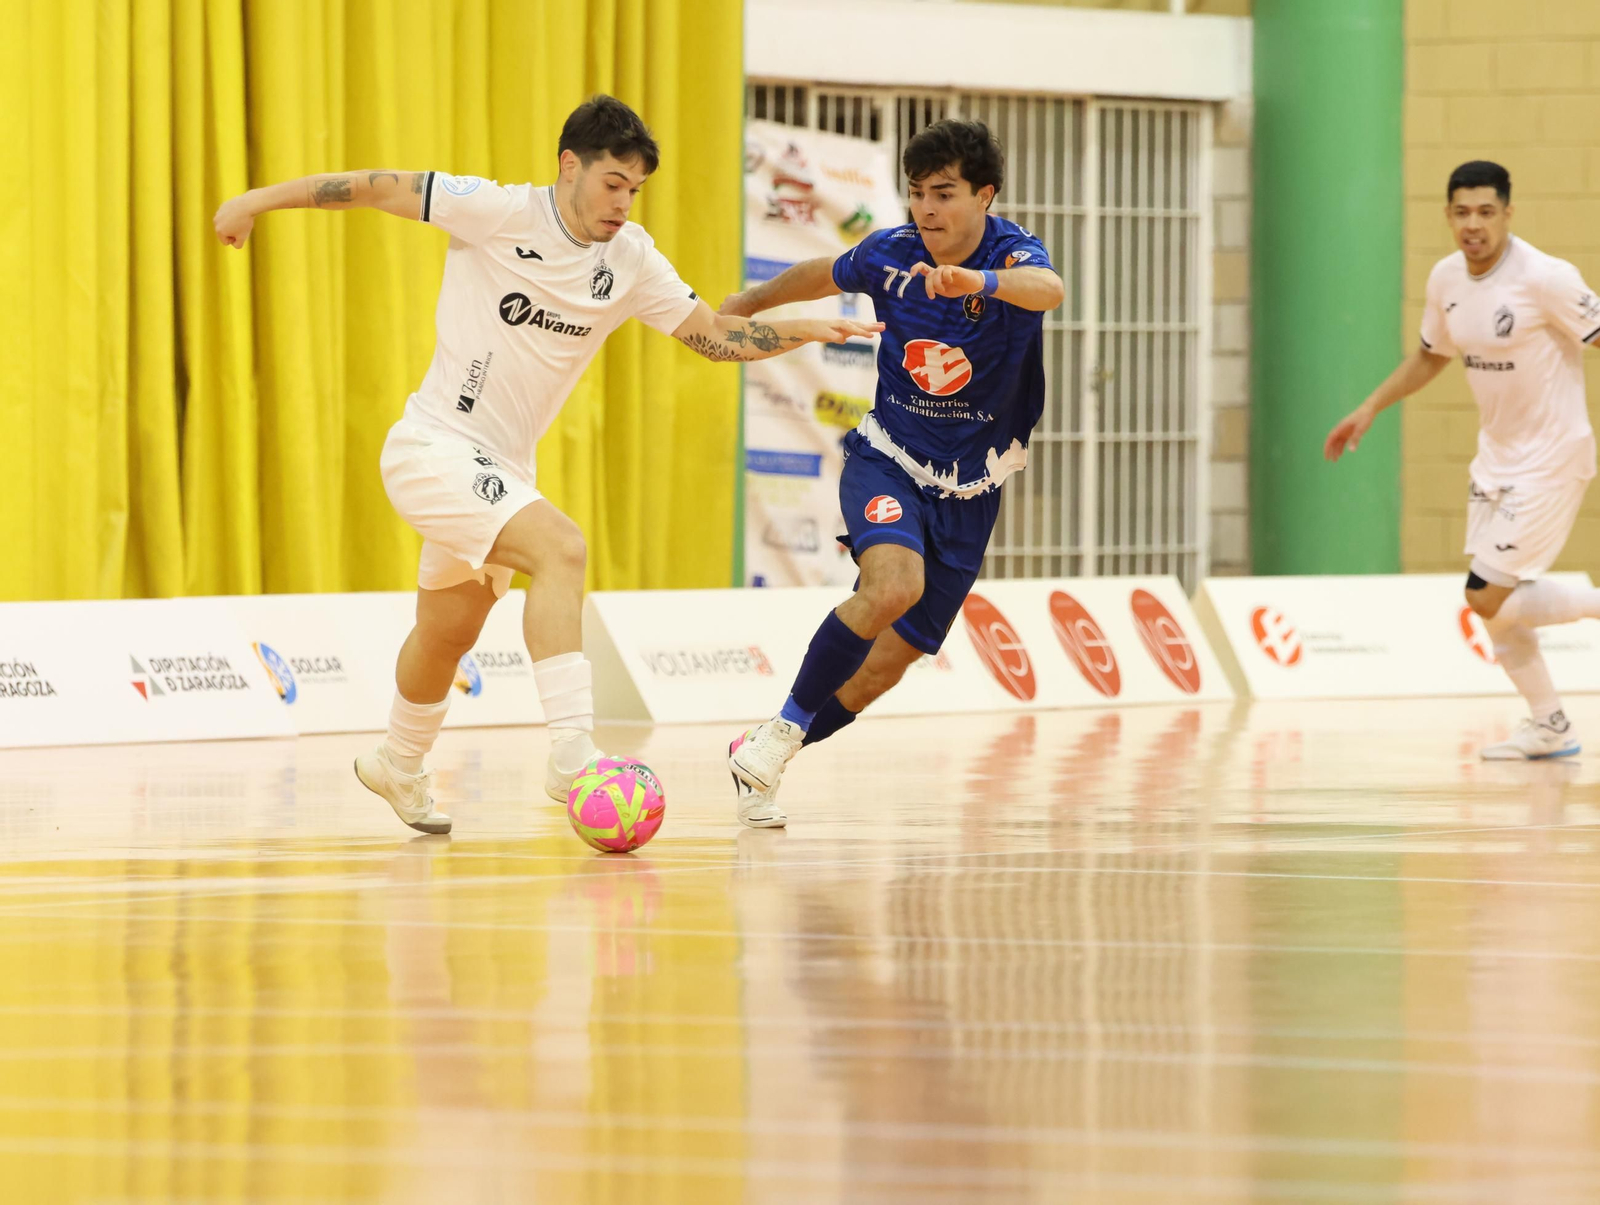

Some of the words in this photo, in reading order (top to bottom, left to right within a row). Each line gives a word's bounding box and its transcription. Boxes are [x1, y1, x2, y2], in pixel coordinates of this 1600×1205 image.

[882, 265, 912, 299] 77
[528, 308, 592, 336] Avanza
[461, 359, 482, 397] Jaén
[910, 394, 970, 408] Entrerríos
[148, 652, 231, 673] DIPUTACIÓN
[290, 655, 343, 674] SOLCAR
[475, 651, 524, 668] SOLCAR
[176, 674, 251, 692] ZARAGOZA
